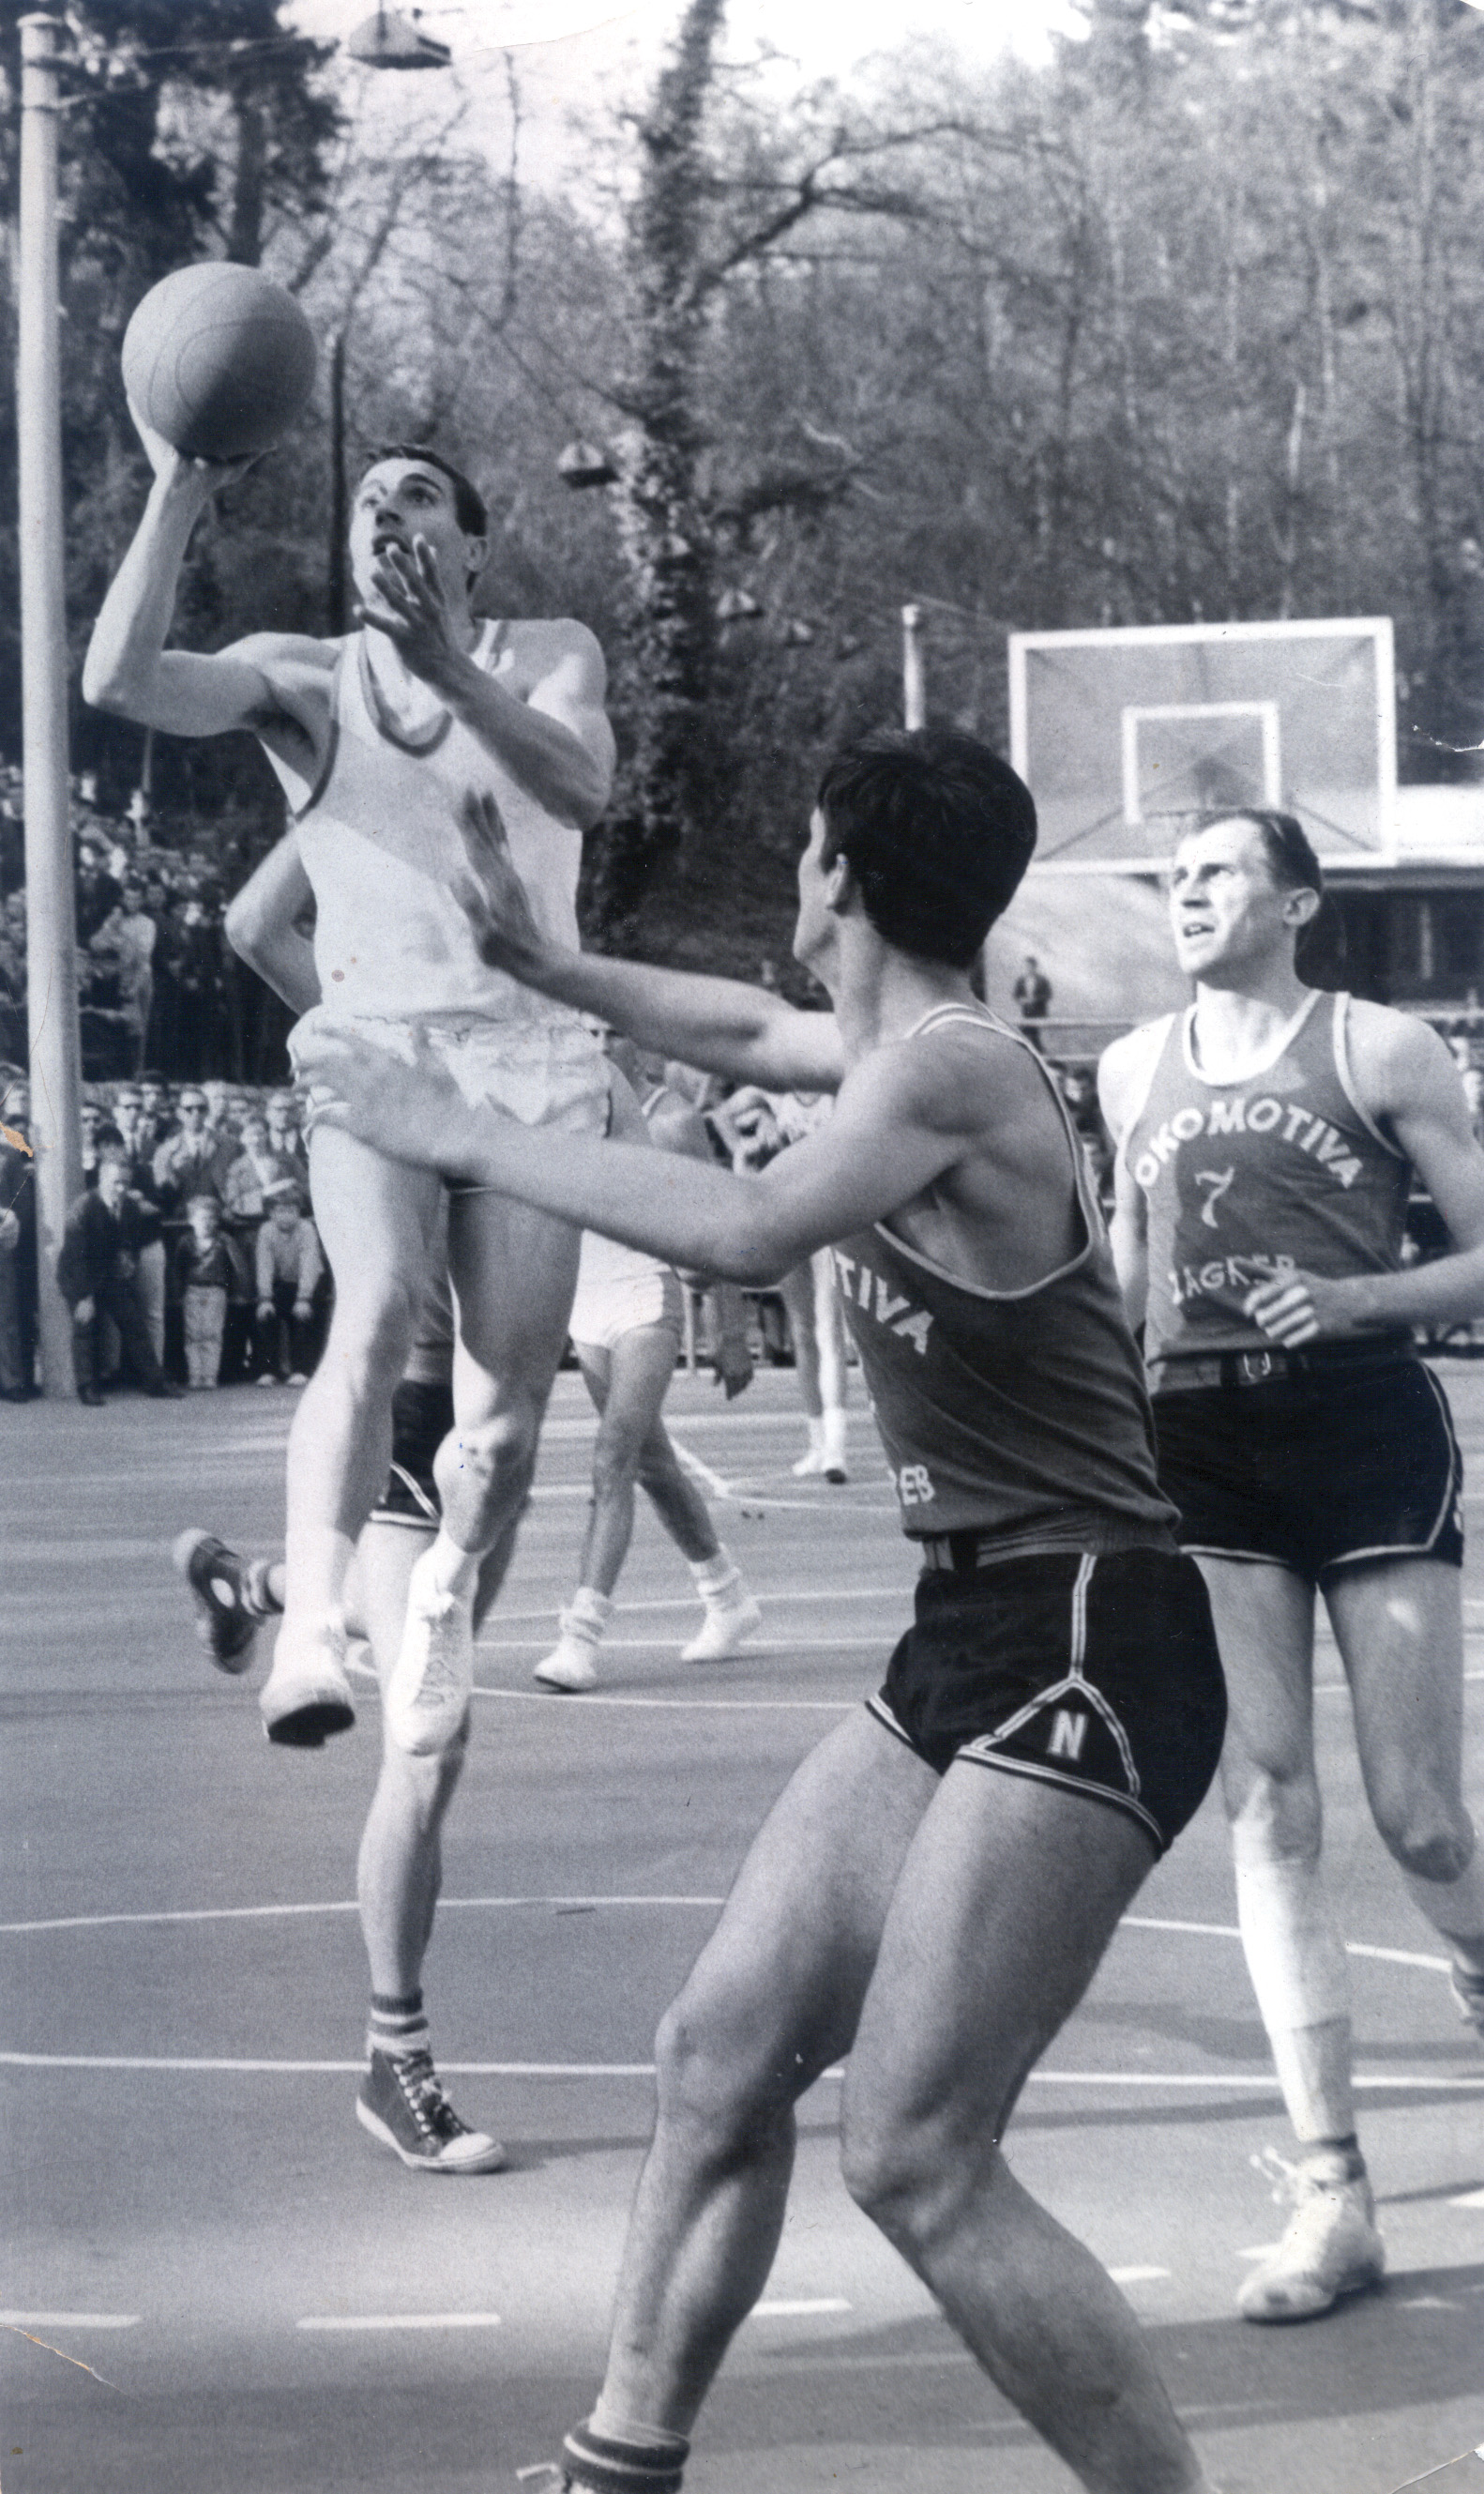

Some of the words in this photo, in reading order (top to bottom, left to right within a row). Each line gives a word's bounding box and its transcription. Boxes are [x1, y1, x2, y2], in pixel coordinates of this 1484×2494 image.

[1134, 1097, 1364, 1190] OKOMOTIVA
[1194, 1165, 1235, 1229] 7
[829, 1247, 935, 1355] TIVA
[900, 1465, 935, 1506] EB
[1048, 1709, 1086, 1761] N
